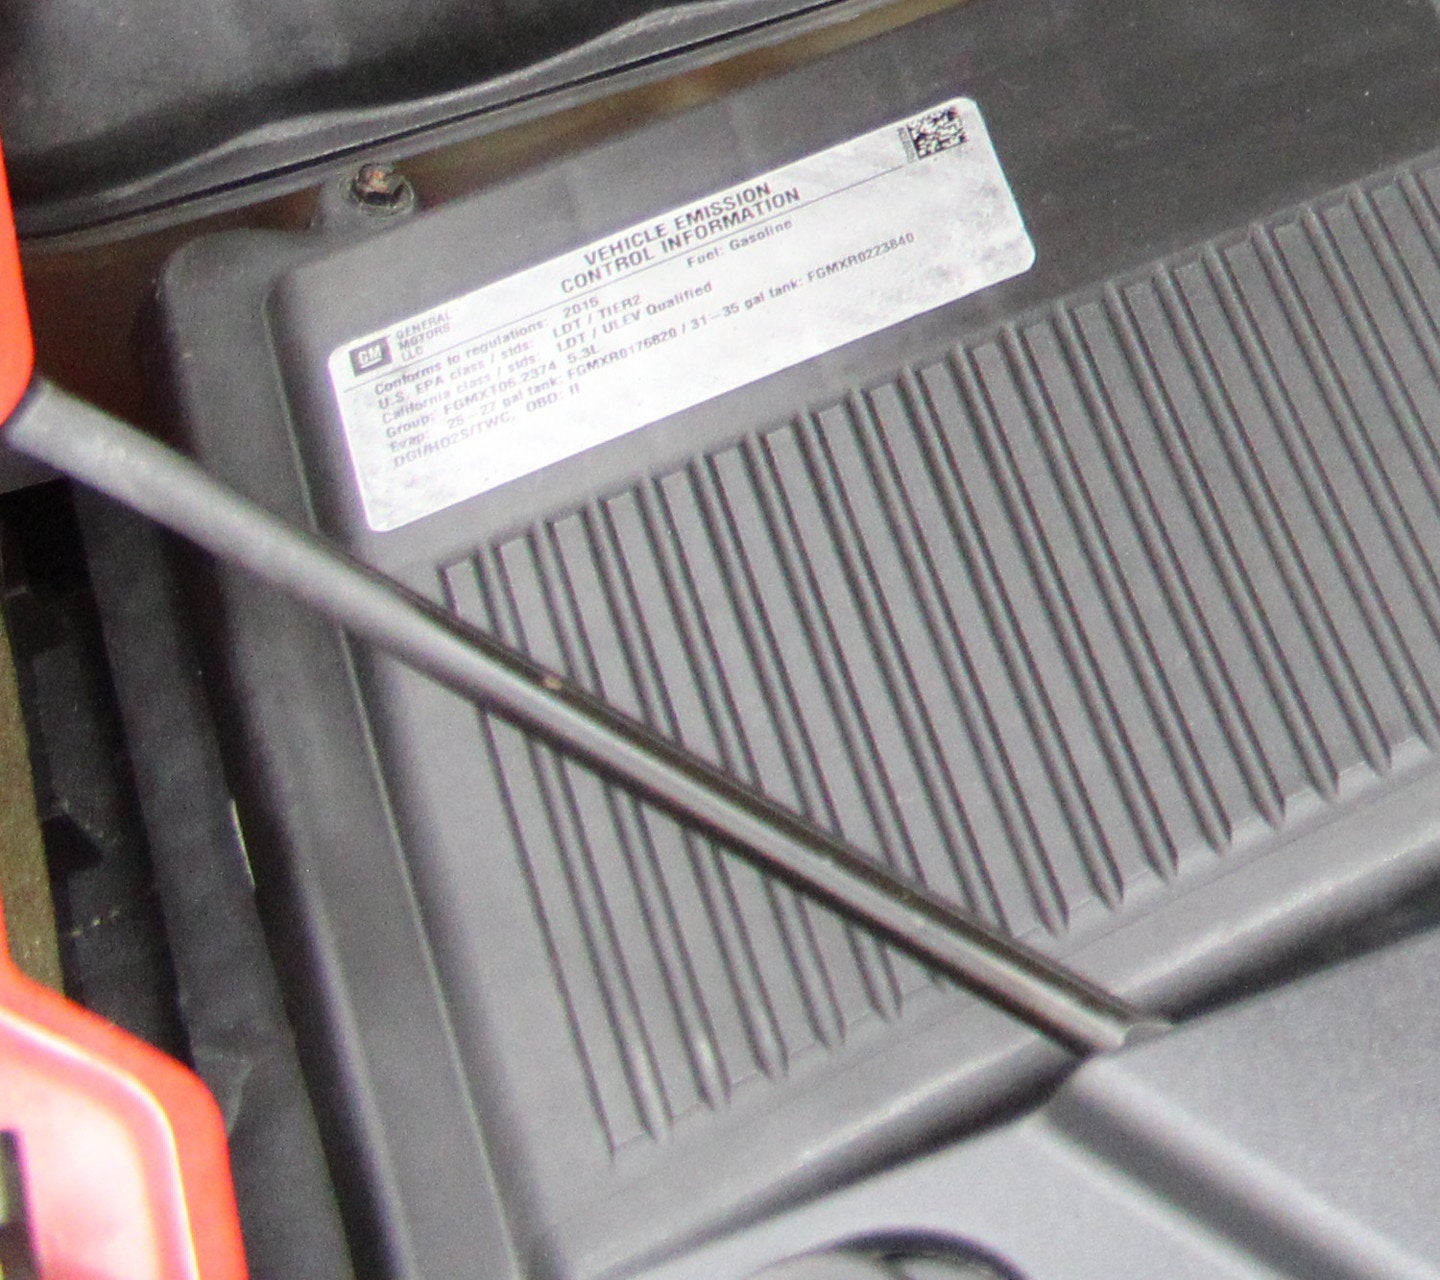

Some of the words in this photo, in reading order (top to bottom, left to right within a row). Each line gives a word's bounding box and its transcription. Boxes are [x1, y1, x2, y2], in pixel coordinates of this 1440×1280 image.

[559, 243, 656, 295] CONTROL
[659, 185, 802, 254] INFORMATION
[582, 221, 668, 268] VEHICLE
[671, 179, 772, 232] EMISSION
[685, 244, 725, 269] Fuel:
[727, 216, 794, 253] Gasoline
[394, 309, 452, 341] GENERAL
[554, 331, 586, 353] LDT
[600, 308, 643, 335] ULEV
[644, 280, 714, 318] Qualified
[742, 290, 766, 311] gal
[767, 275, 804, 299] tank:
[373, 359, 443, 396] Conforms
[445, 351, 461, 367] to
[463, 315, 551, 361] regulations:
[560, 294, 600, 319] 2015
[397, 321, 451, 351] MOTORS
[413, 373, 445, 395] EPA
[550, 316, 583, 339] LDT
[597, 292, 642, 320] TIER2
